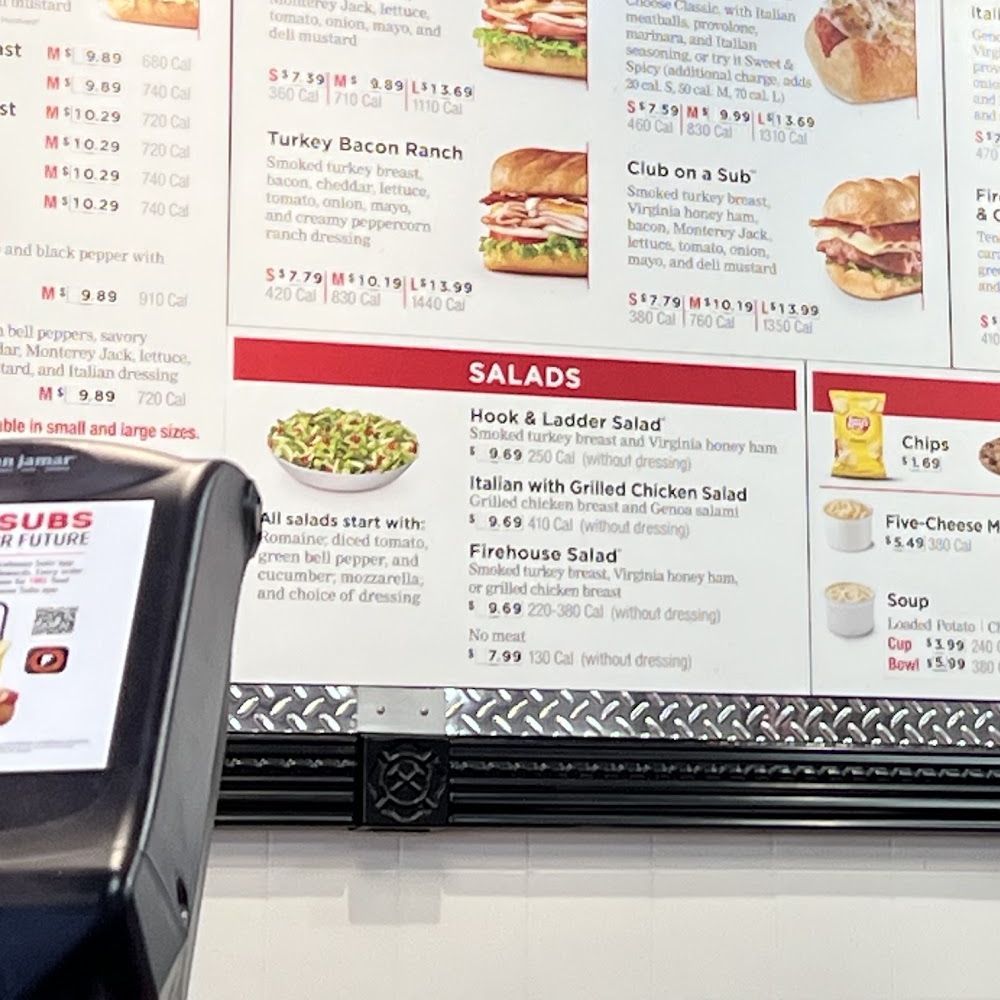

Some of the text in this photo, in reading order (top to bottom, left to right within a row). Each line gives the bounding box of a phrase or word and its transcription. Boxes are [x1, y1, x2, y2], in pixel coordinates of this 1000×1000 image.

[269, 26, 357, 46] deli mustard
[47, 45, 60, 60] M
[268, 130, 462, 161] Turkey Bacon Ranch
[627, 160, 668, 177] Club
[674, 167, 696, 179] on
[702, 169, 711, 181] a
[8, 324, 33, 341] bell
[100, 331, 147, 348] savory
[38, 361, 178, 387] and Italian dressing
[469, 363, 580, 389] SALADS
[471, 408, 518, 425] Hook
[524, 410, 535, 426] &
[542, 411, 606, 429] Ladder
[30, 419, 42, 434] in
[46, 419, 85, 435] small
[90, 421, 116, 436] and
[120, 422, 156, 441] large
[470, 427, 777, 455] Smoked turkey breast and Virginia honey ham
[902, 435, 949, 454] Chips
[470, 476, 746, 502] Italian with Grilled Chicken Salad
[469, 496, 738, 517] Grilled chicken breast and Genoa salami
[0, 511, 92, 531] SUBS
[261, 509, 280, 527] All
[286, 510, 337, 528] salads
[343, 512, 380, 530] start
[886, 515, 982, 533] Five-Cheese
[18, 532, 88, 546] FUTURE
[258, 551, 299, 568] green
[304, 548, 330, 566] bell
[392, 551, 418, 568] and
[470, 544, 561, 562] Firehouse
[257, 584, 421, 608] and choice of dressing
[887, 593, 928, 611] Soup
[469, 630, 525, 643] No meat
[887, 637, 911, 653] Cup
[888, 658, 919, 671] Bowl
